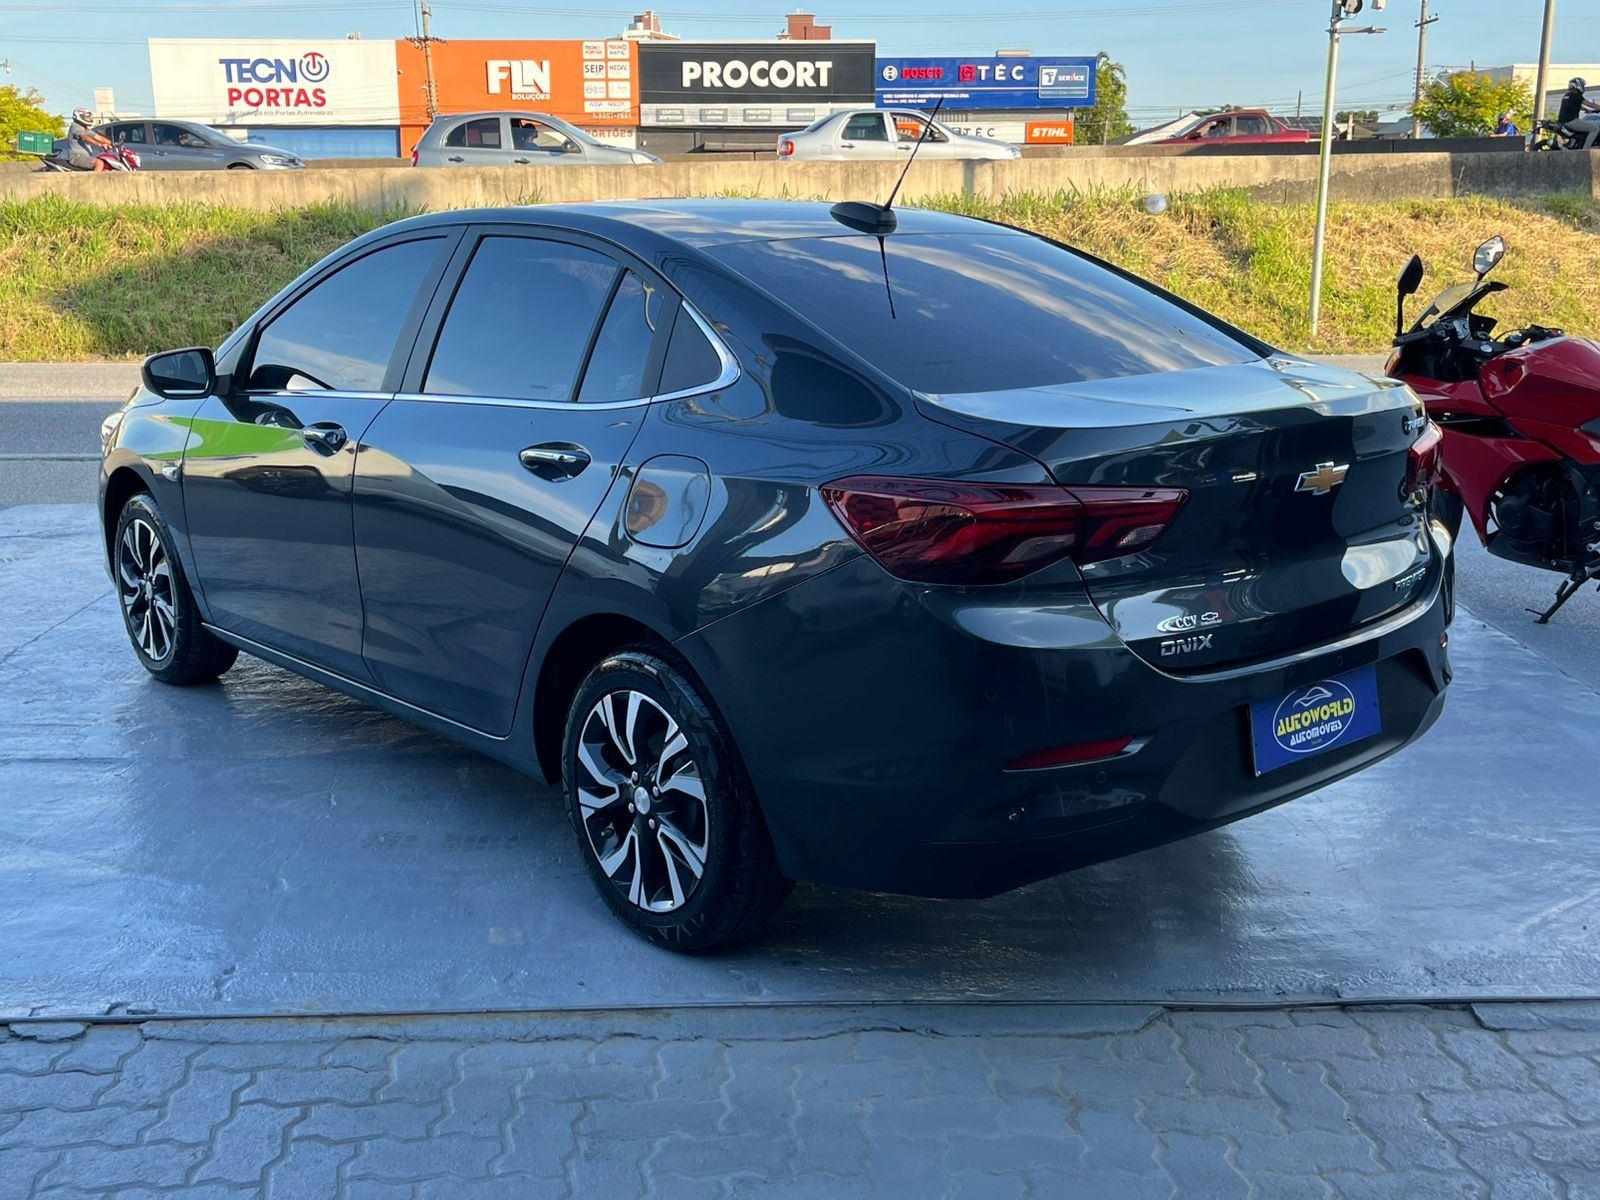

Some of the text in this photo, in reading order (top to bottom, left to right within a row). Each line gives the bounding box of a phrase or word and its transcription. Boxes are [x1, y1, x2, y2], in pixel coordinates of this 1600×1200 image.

[585, 64, 604, 73] SEIP
[682, 60, 832, 88] PROCORT
[902, 68, 943, 79] BOSCH
[228, 88, 326, 107] PORTAS
[512, 93, 551, 101] SOLUÇÕES
[585, 127, 634, 138] PORTÕES
[1032, 128, 1069, 138] STIHL
[1176, 615, 1197, 629] CCV
[1160, 634, 1213, 657] ONIX
[1277, 698, 1353, 737] AUTOWORLD
[1290, 719, 1342, 747] AUTOMÓVEIS
